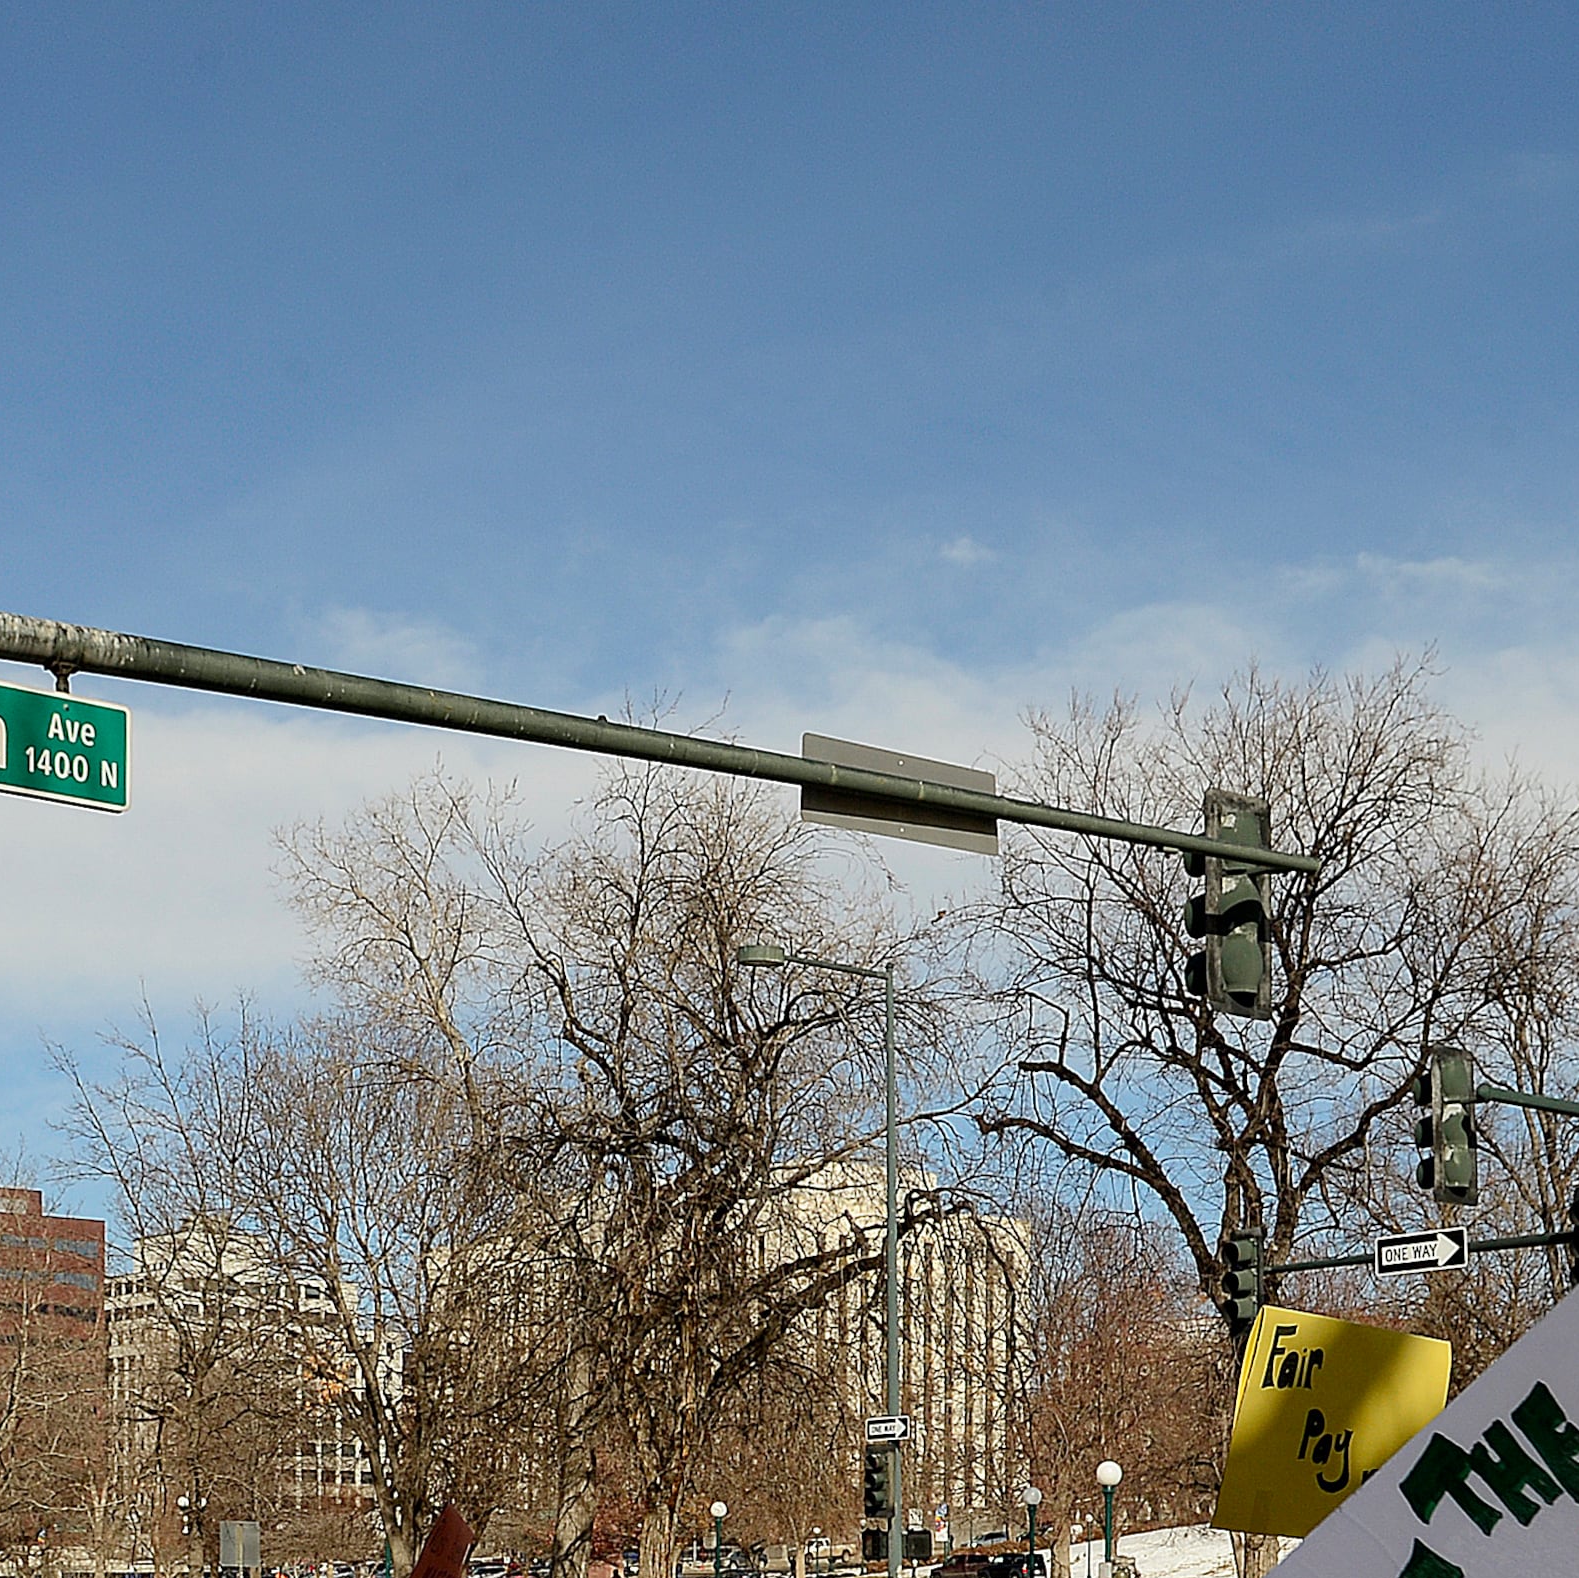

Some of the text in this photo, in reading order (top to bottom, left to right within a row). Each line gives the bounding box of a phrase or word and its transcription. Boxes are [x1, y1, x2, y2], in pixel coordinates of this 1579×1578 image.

[48, 712, 96, 747] Ave
[25, 746, 119, 788] 1400 N
[1385, 1244, 1437, 1262] ONE WAY
[1260, 1325, 1324, 1390] Fair
[1297, 1409, 1354, 1493] Pay
